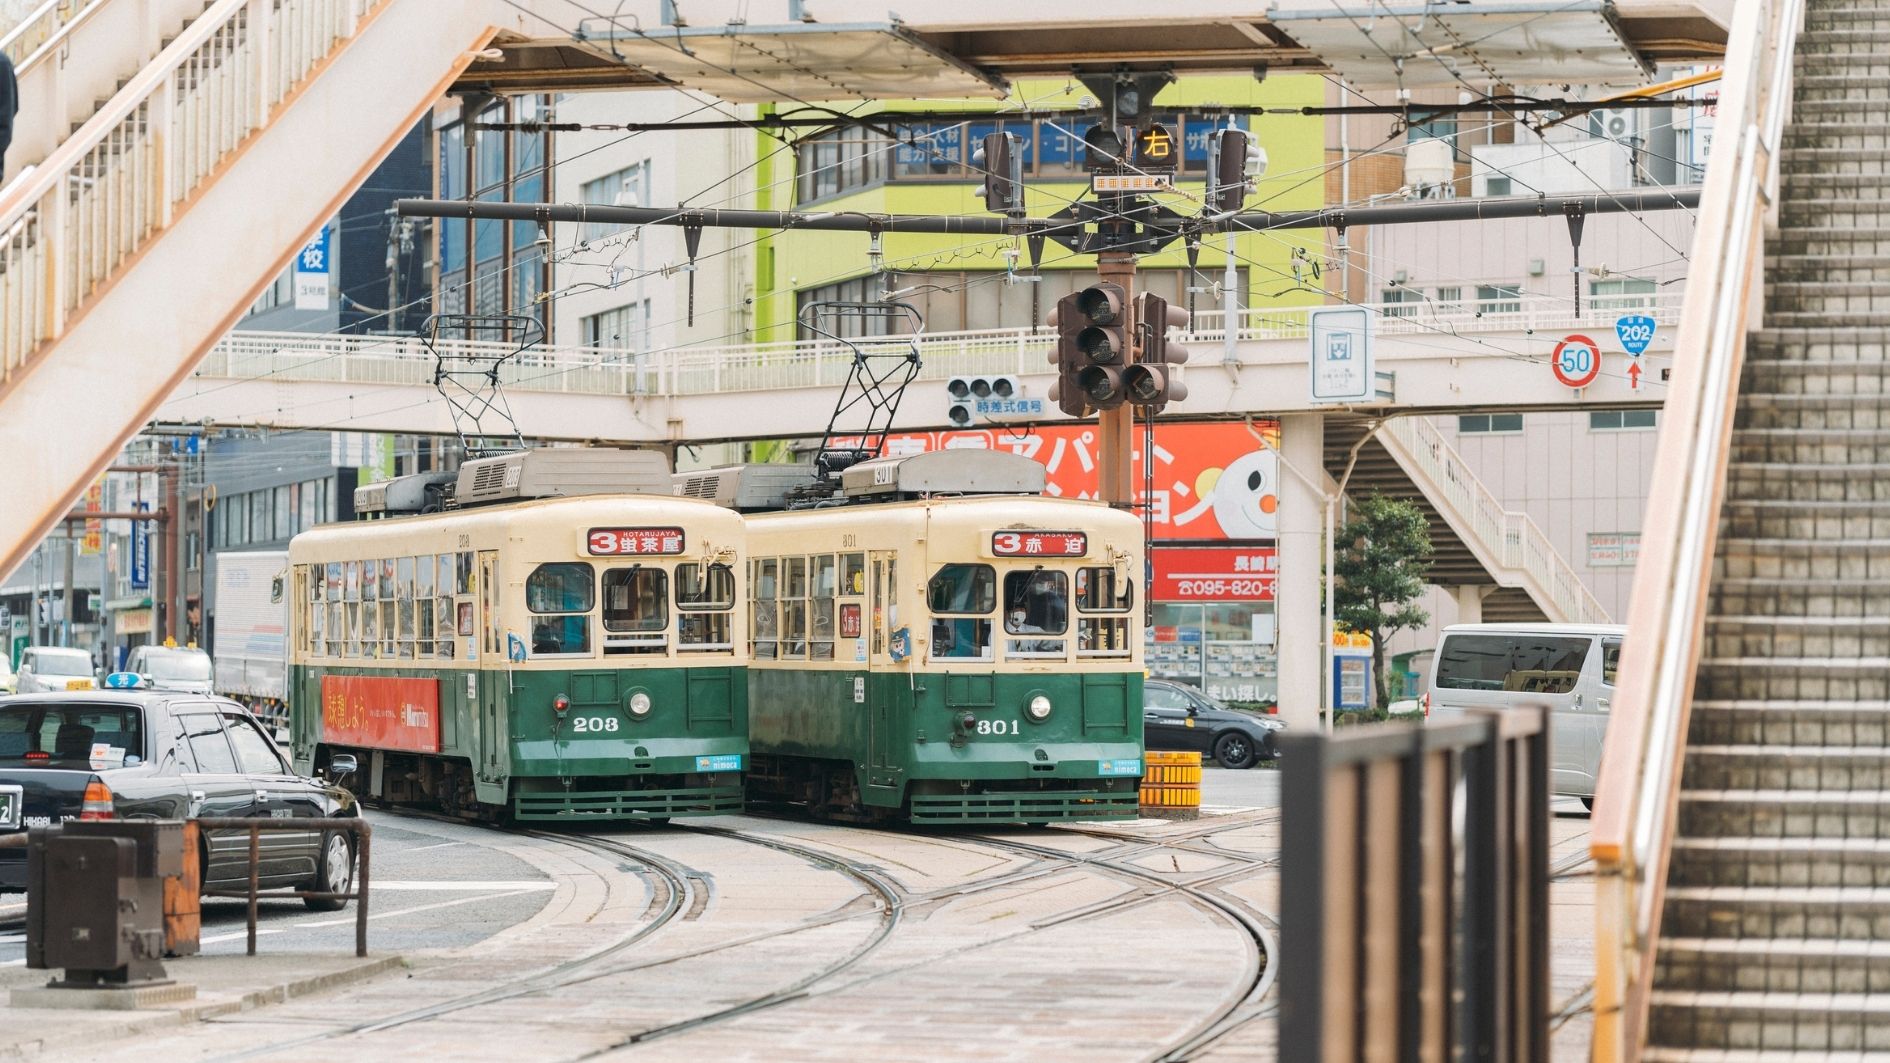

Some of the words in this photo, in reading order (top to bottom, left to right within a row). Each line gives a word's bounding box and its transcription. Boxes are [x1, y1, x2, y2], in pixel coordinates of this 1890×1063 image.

[1144, 131, 1169, 156] 右
[1622, 325, 1650, 341] 202
[1563, 349, 1589, 372] 50
[977, 400, 1041, 413] 時差式信号
[875, 466, 892, 484] 301
[590, 532, 618, 552] 3
[620, 537, 680, 552] 蛍茶屋
[995, 533, 1021, 552] 3
[118, 673, 128, 686] 光
[573, 717, 619, 733] 203
[977, 720, 1020, 735] 301
[713, 761, 737, 769] nimoca
[23, 816, 51, 826] HIKARI
